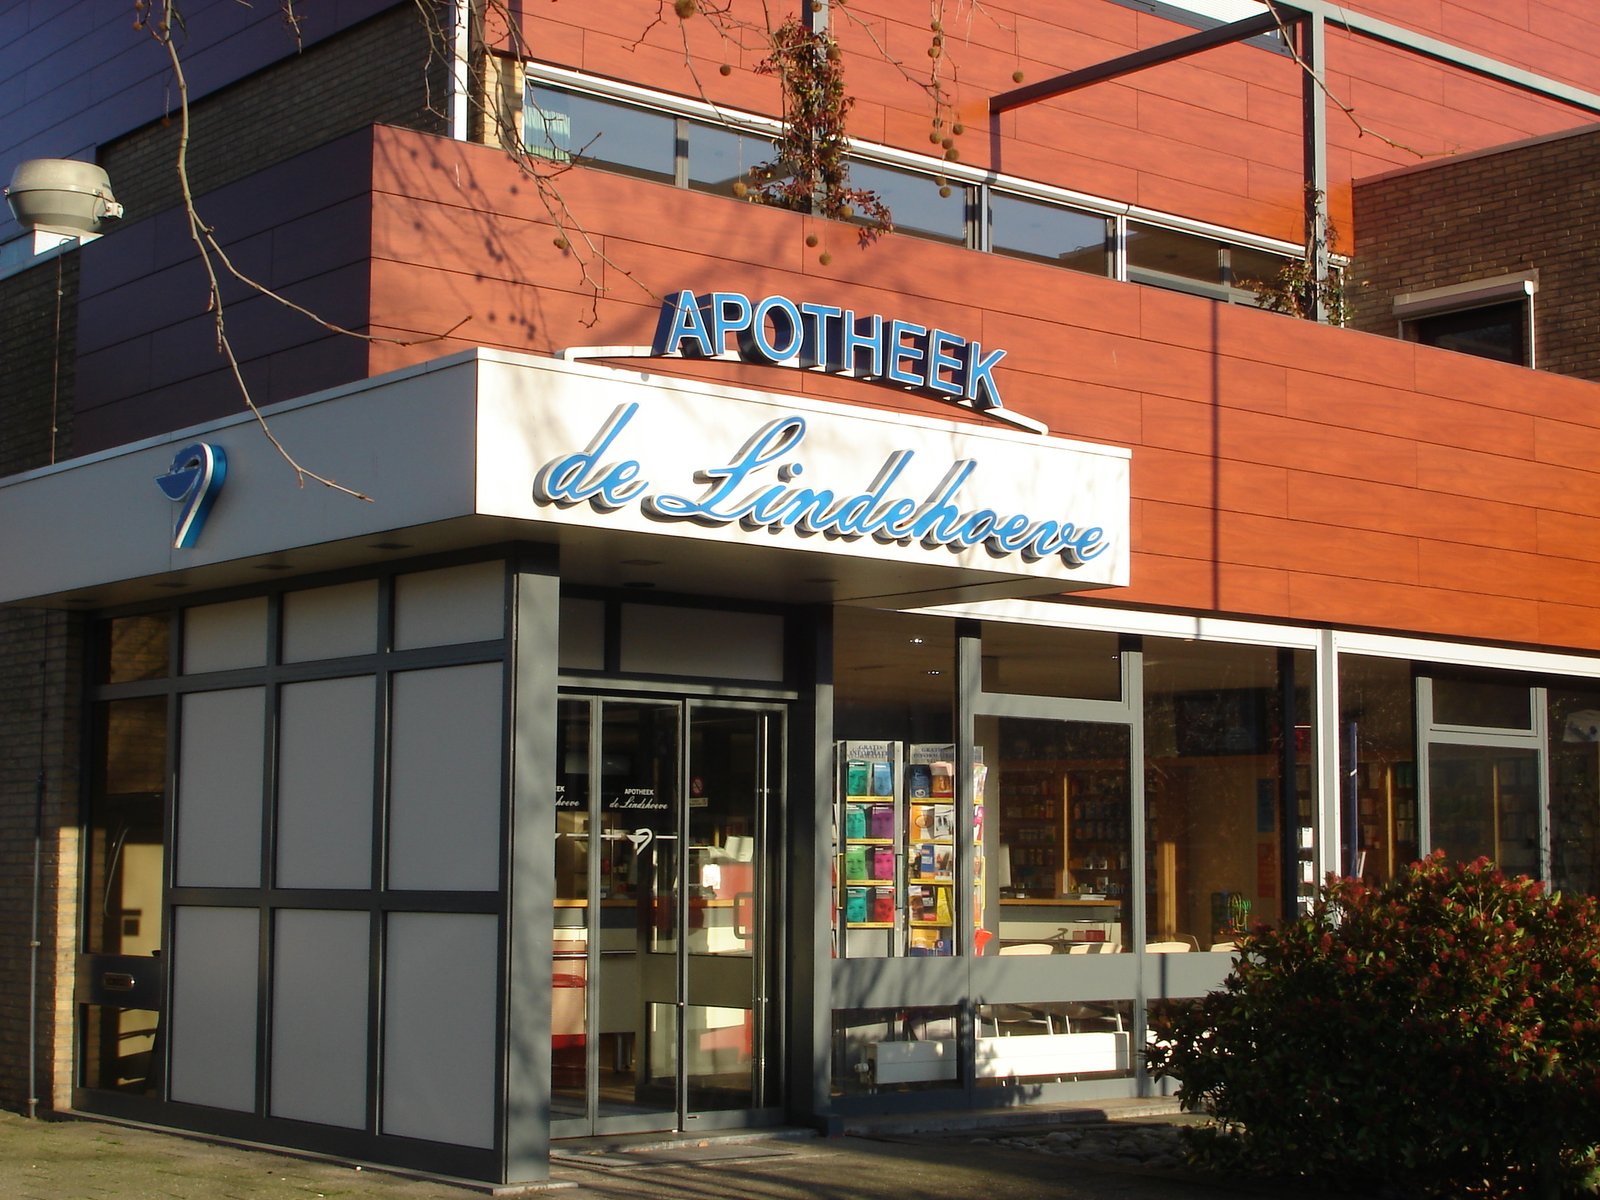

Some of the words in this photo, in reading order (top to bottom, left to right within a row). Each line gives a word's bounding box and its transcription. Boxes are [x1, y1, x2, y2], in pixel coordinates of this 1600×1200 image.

[660, 289, 1008, 408] APOTHEEK
[539, 402, 649, 508] de
[648, 416, 1110, 567] Lindehoeve
[609, 797, 620, 809] de
[624, 788, 655, 796] APOTHEEK
